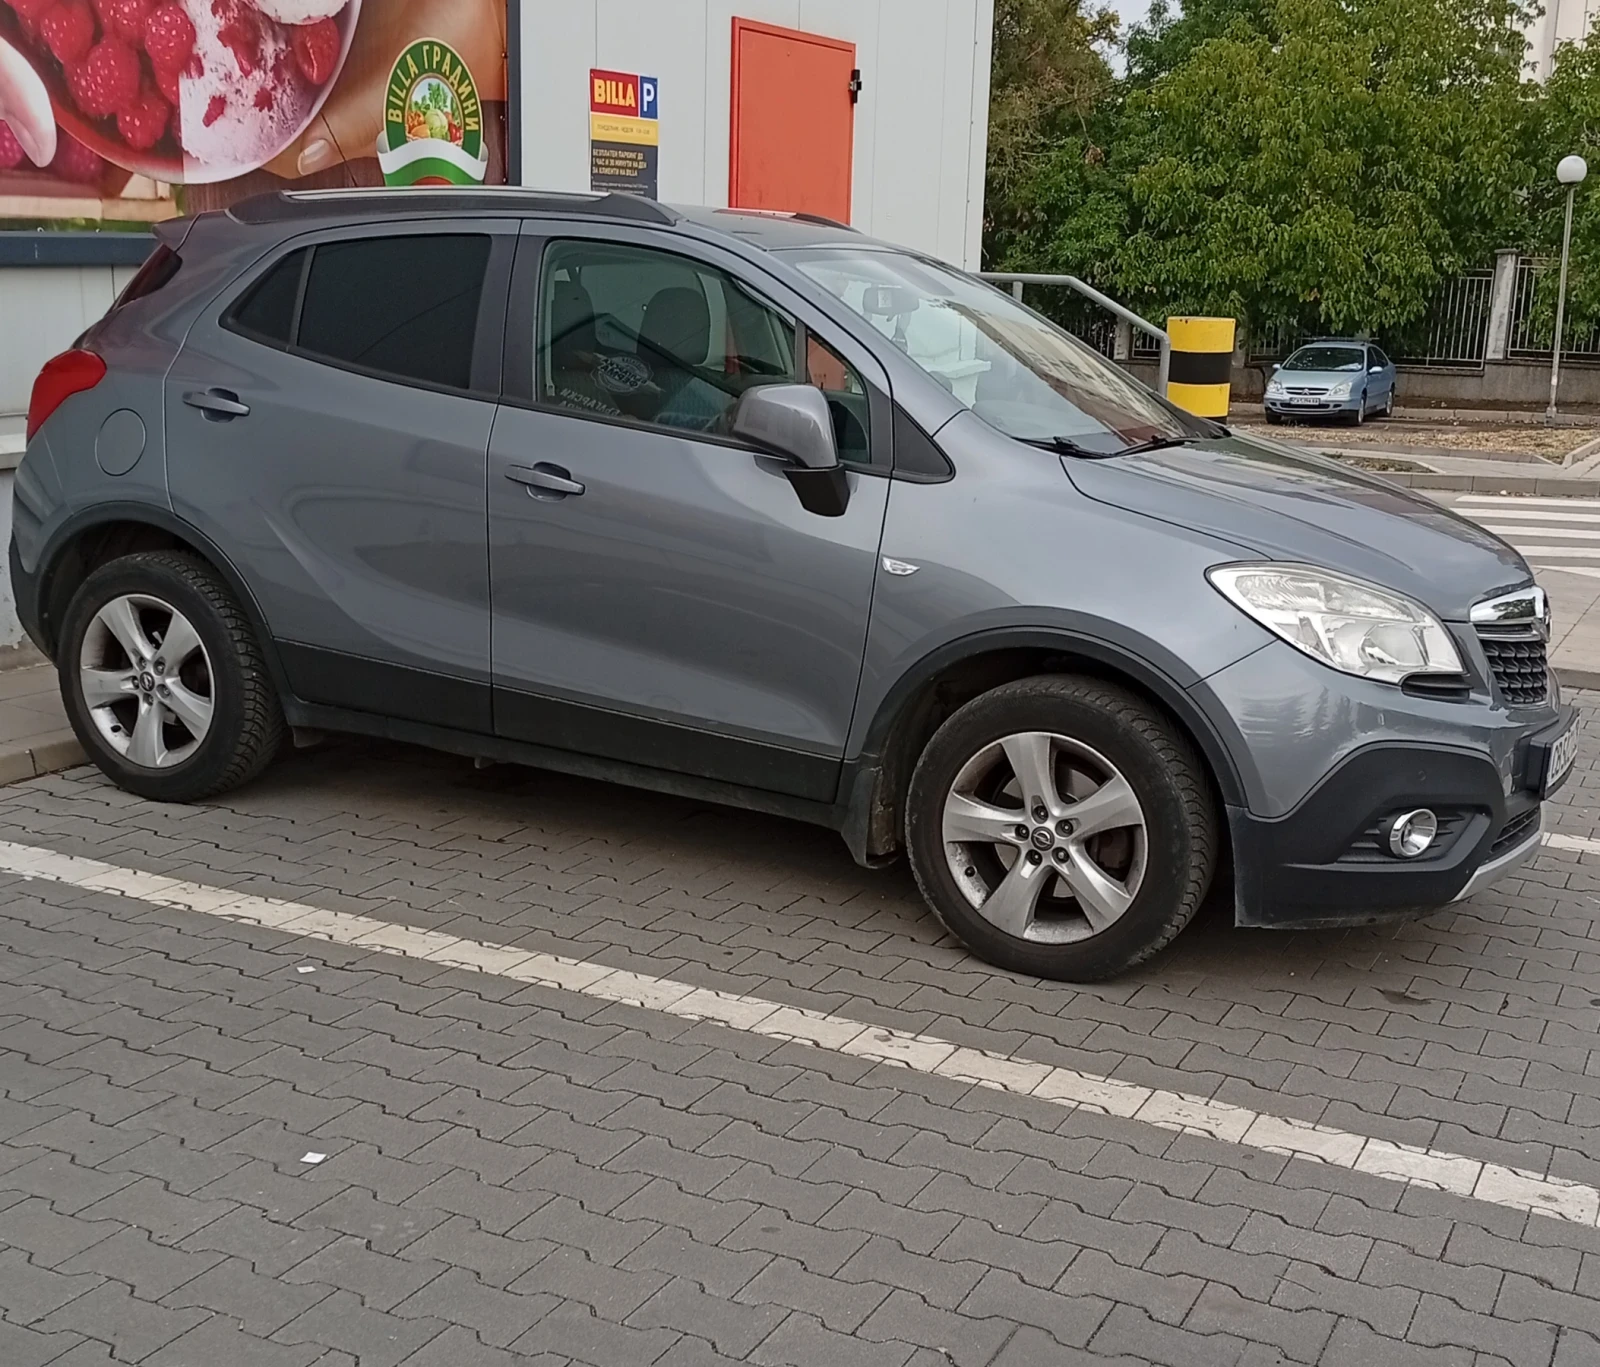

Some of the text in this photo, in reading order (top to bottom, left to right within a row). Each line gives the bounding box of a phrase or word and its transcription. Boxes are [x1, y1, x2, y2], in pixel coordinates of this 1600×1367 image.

[387, 44, 480, 131] BILLA ГРАДИНИ
[593, 78, 655, 112] BILLA P
